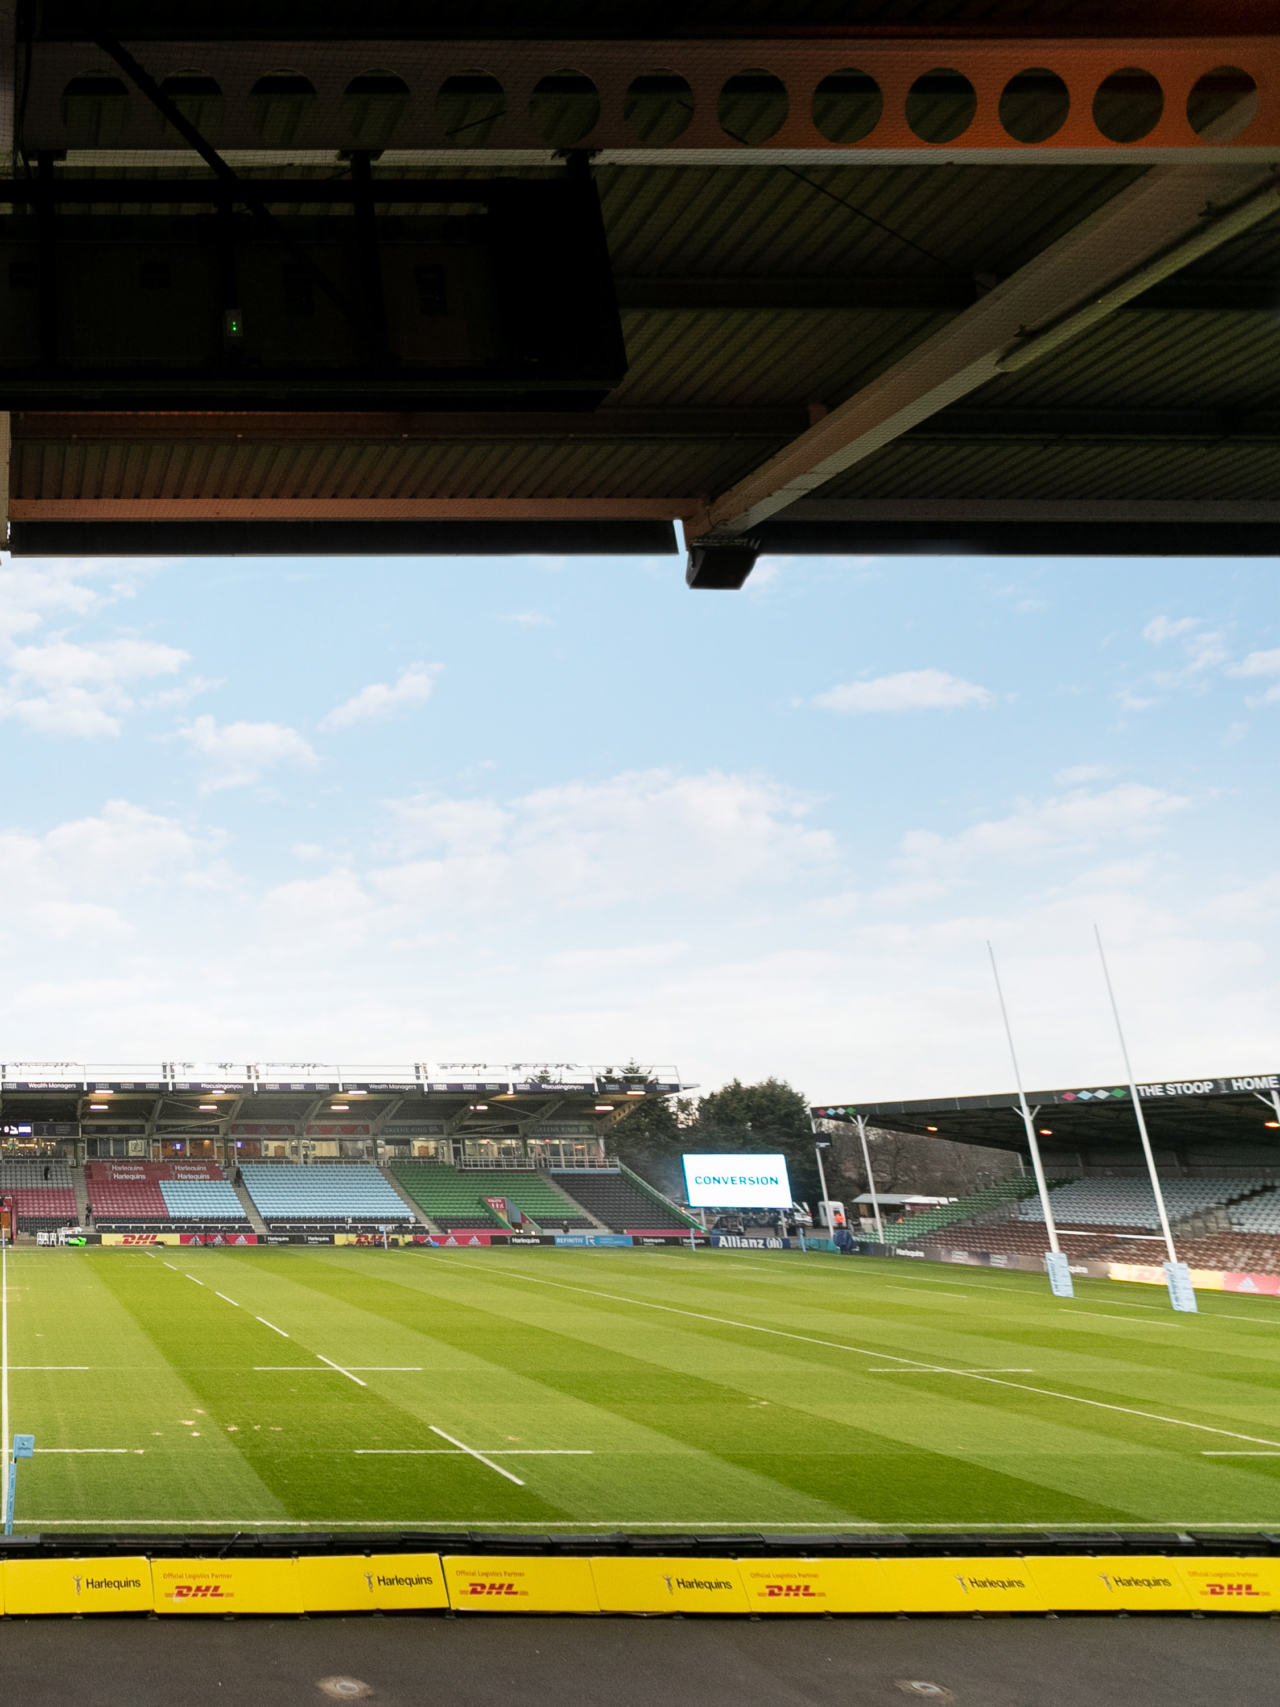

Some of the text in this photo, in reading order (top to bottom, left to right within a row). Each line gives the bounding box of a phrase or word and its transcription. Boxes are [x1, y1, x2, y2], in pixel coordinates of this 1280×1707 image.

[1137, 1081, 1214, 1097] THE STOOP
[1231, 1076, 1280, 1091] HOME
[694, 1176, 779, 1186] CONVERSION
[122, 1234, 157, 1244] DHL
[718, 1235, 765, 1249] Allianz
[185, 1573, 209, 1581] Logistics
[455, 1570, 525, 1578] Official Logistics Partner
[86, 1577, 141, 1591] Harlequins
[377, 1574, 433, 1588] Harlequins
[676, 1578, 732, 1591] Harlequins
[968, 1577, 1025, 1590] Harlequins
[1113, 1576, 1172, 1589] Harlequins
[175, 1585, 224, 1598] DHL
[469, 1583, 519, 1595] DHL
[765, 1585, 816, 1597] DHL
[1206, 1584, 1260, 1596] DHL
